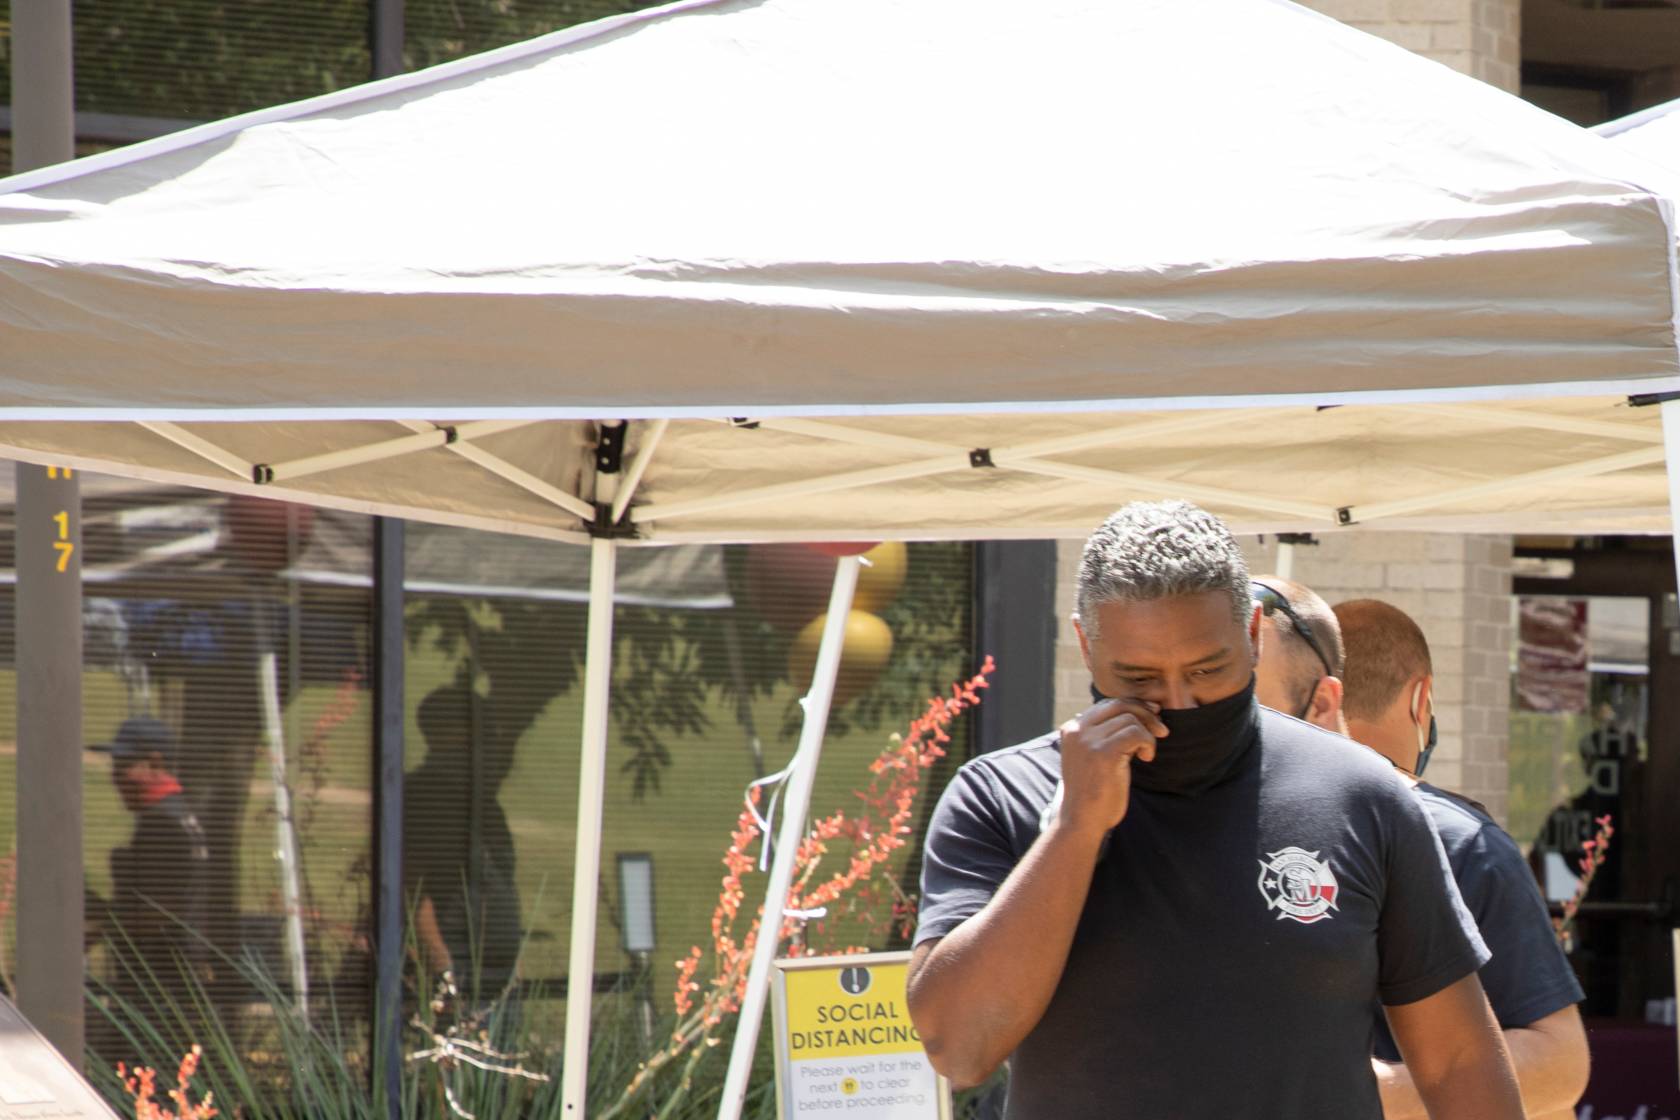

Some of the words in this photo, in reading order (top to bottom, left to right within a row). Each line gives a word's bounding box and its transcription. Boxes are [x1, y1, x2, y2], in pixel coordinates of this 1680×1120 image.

[817, 1002, 899, 1023] SOCIAL
[800, 1065, 844, 1078] Please
[847, 1063, 876, 1075] wait
[879, 1061, 898, 1073] for
[899, 1059, 922, 1072] the
[809, 1081, 838, 1094] next
[860, 1079, 875, 1090] to
[877, 1077, 911, 1089] clear
[798, 1098, 843, 1111] before
